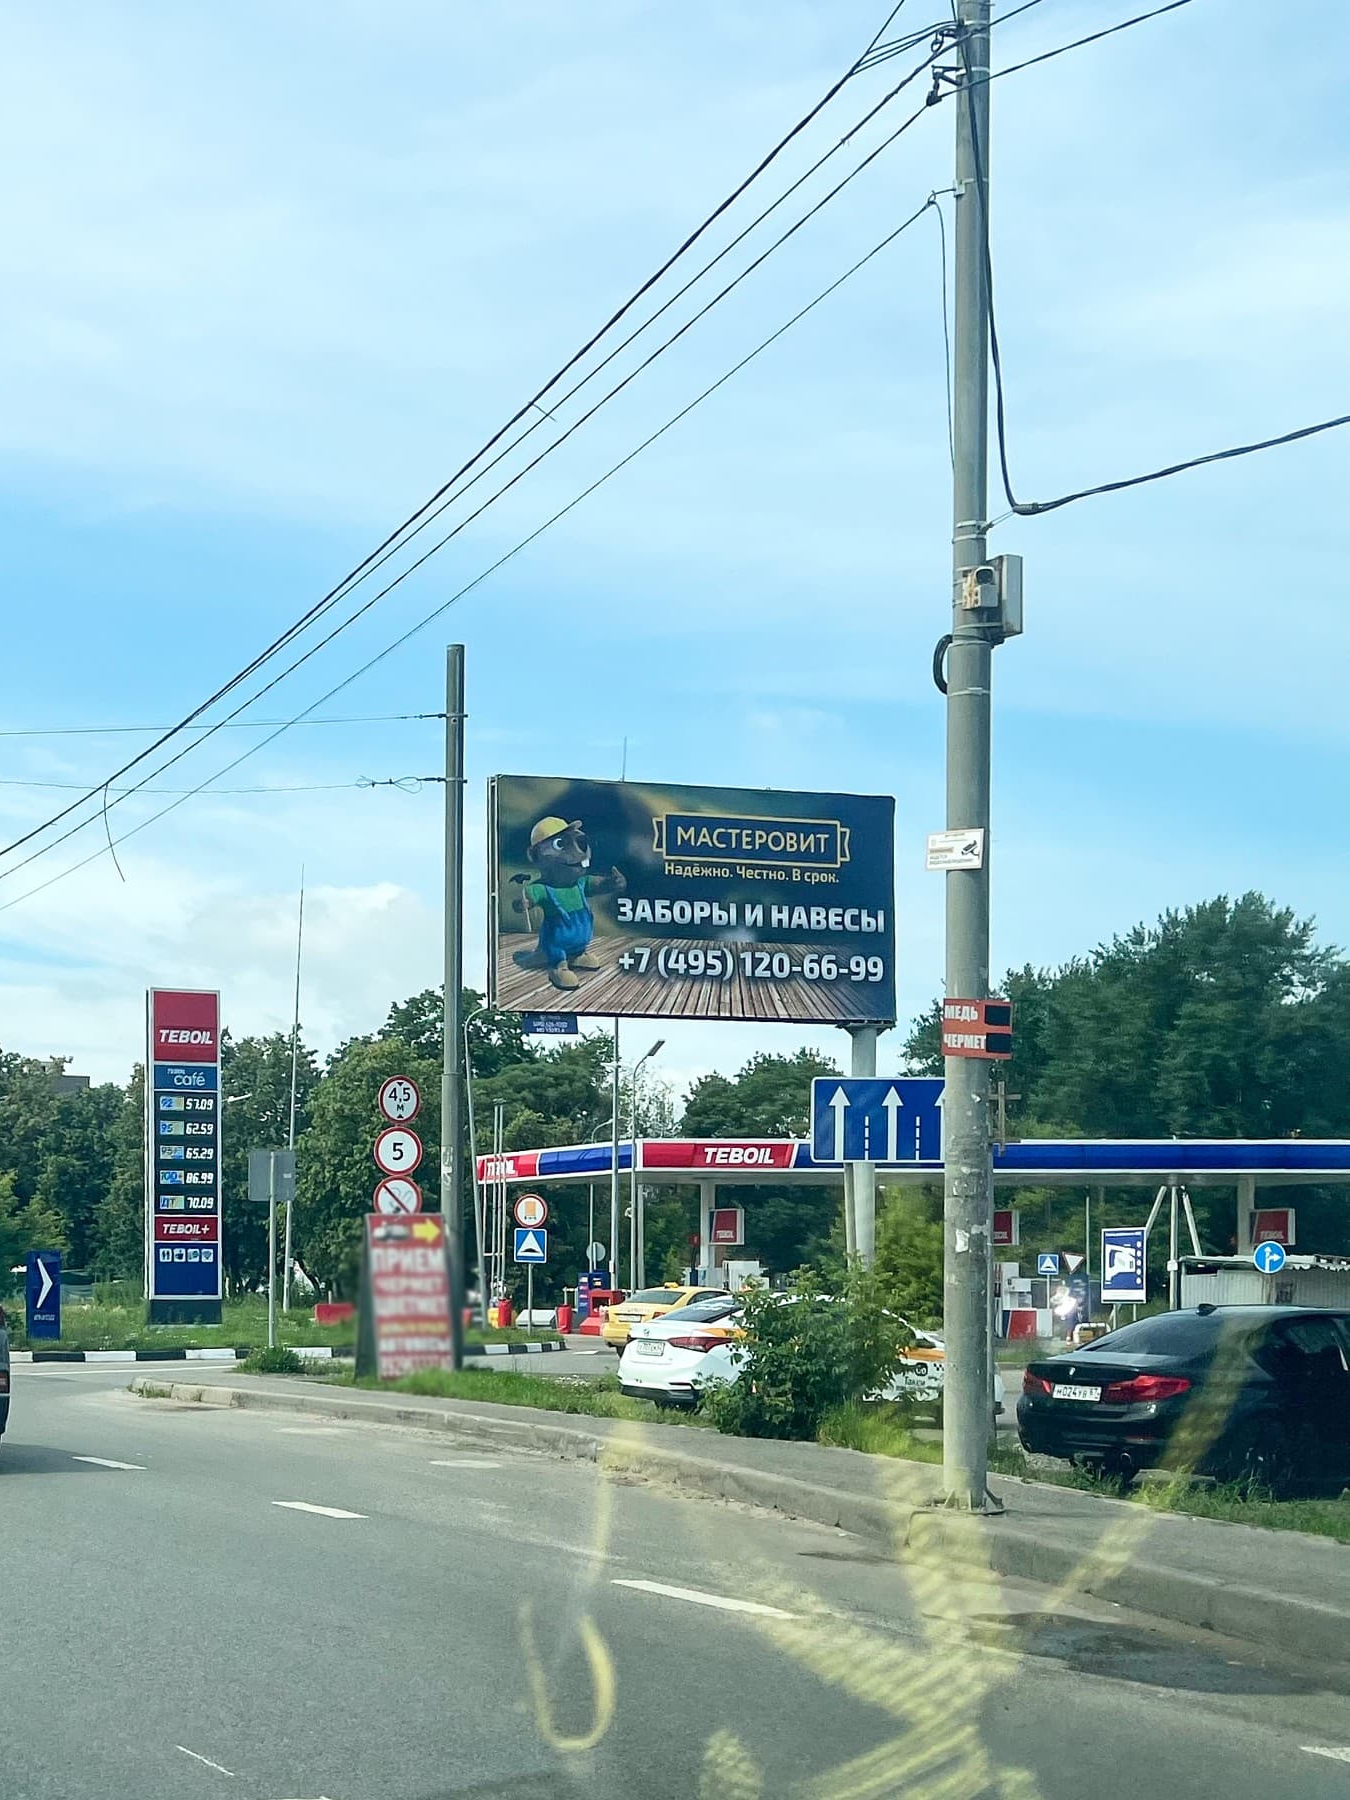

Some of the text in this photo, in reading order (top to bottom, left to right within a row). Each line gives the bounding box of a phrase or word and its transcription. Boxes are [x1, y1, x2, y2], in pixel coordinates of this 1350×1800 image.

[676, 825, 830, 853] МАСТЕРОВИТ
[736, 866, 789, 881] Честно.
[792, 869, 801, 881] В
[804, 872, 840, 885] срок.
[617, 898, 885, 933] ЗАБОРЫ И НАВЕСЫ
[618, 946, 884, 982] +7 (495) 120-66-99
[944, 1005, 978, 1022] МЕДЬ
[159, 1029, 213, 1045] TEBOIL
[943, 1033, 986, 1050] ЧЕРМЕТ
[173, 1072, 206, 1087] café
[388, 1087, 411, 1103] 4,5
[185, 1098, 214, 1111] 57.09
[185, 1122, 214, 1135] 62.59
[392, 1142, 404, 1161] 5
[704, 1147, 775, 1164] TEBOIL
[186, 1196, 215, 1209] 70.09
